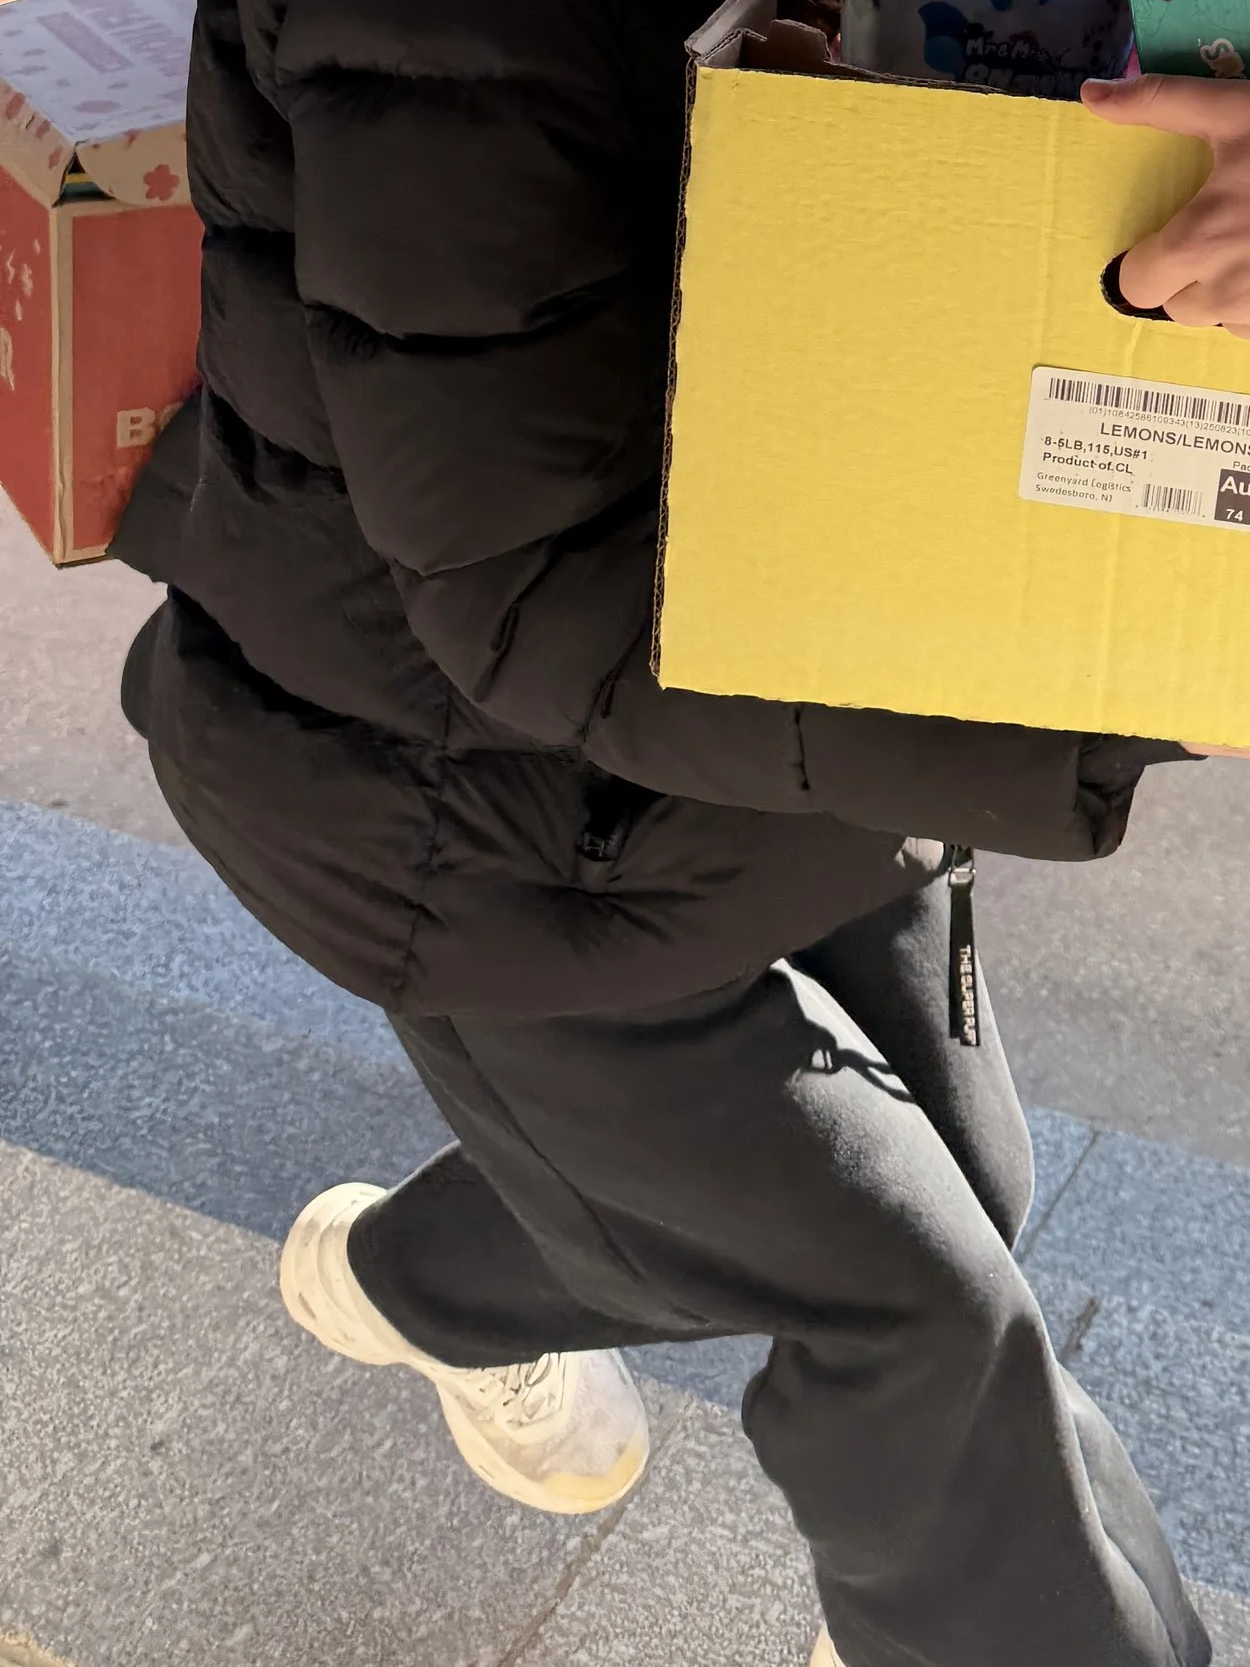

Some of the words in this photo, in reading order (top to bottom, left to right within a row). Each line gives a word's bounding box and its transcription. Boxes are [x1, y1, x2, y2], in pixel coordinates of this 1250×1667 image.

[1042, 452, 1096, 469] Product
[1099, 461, 1112, 471] of
[1115, 463, 1133, 474] CL
[1226, 508, 1244, 522] 74
[959, 944, 973, 973] THE
